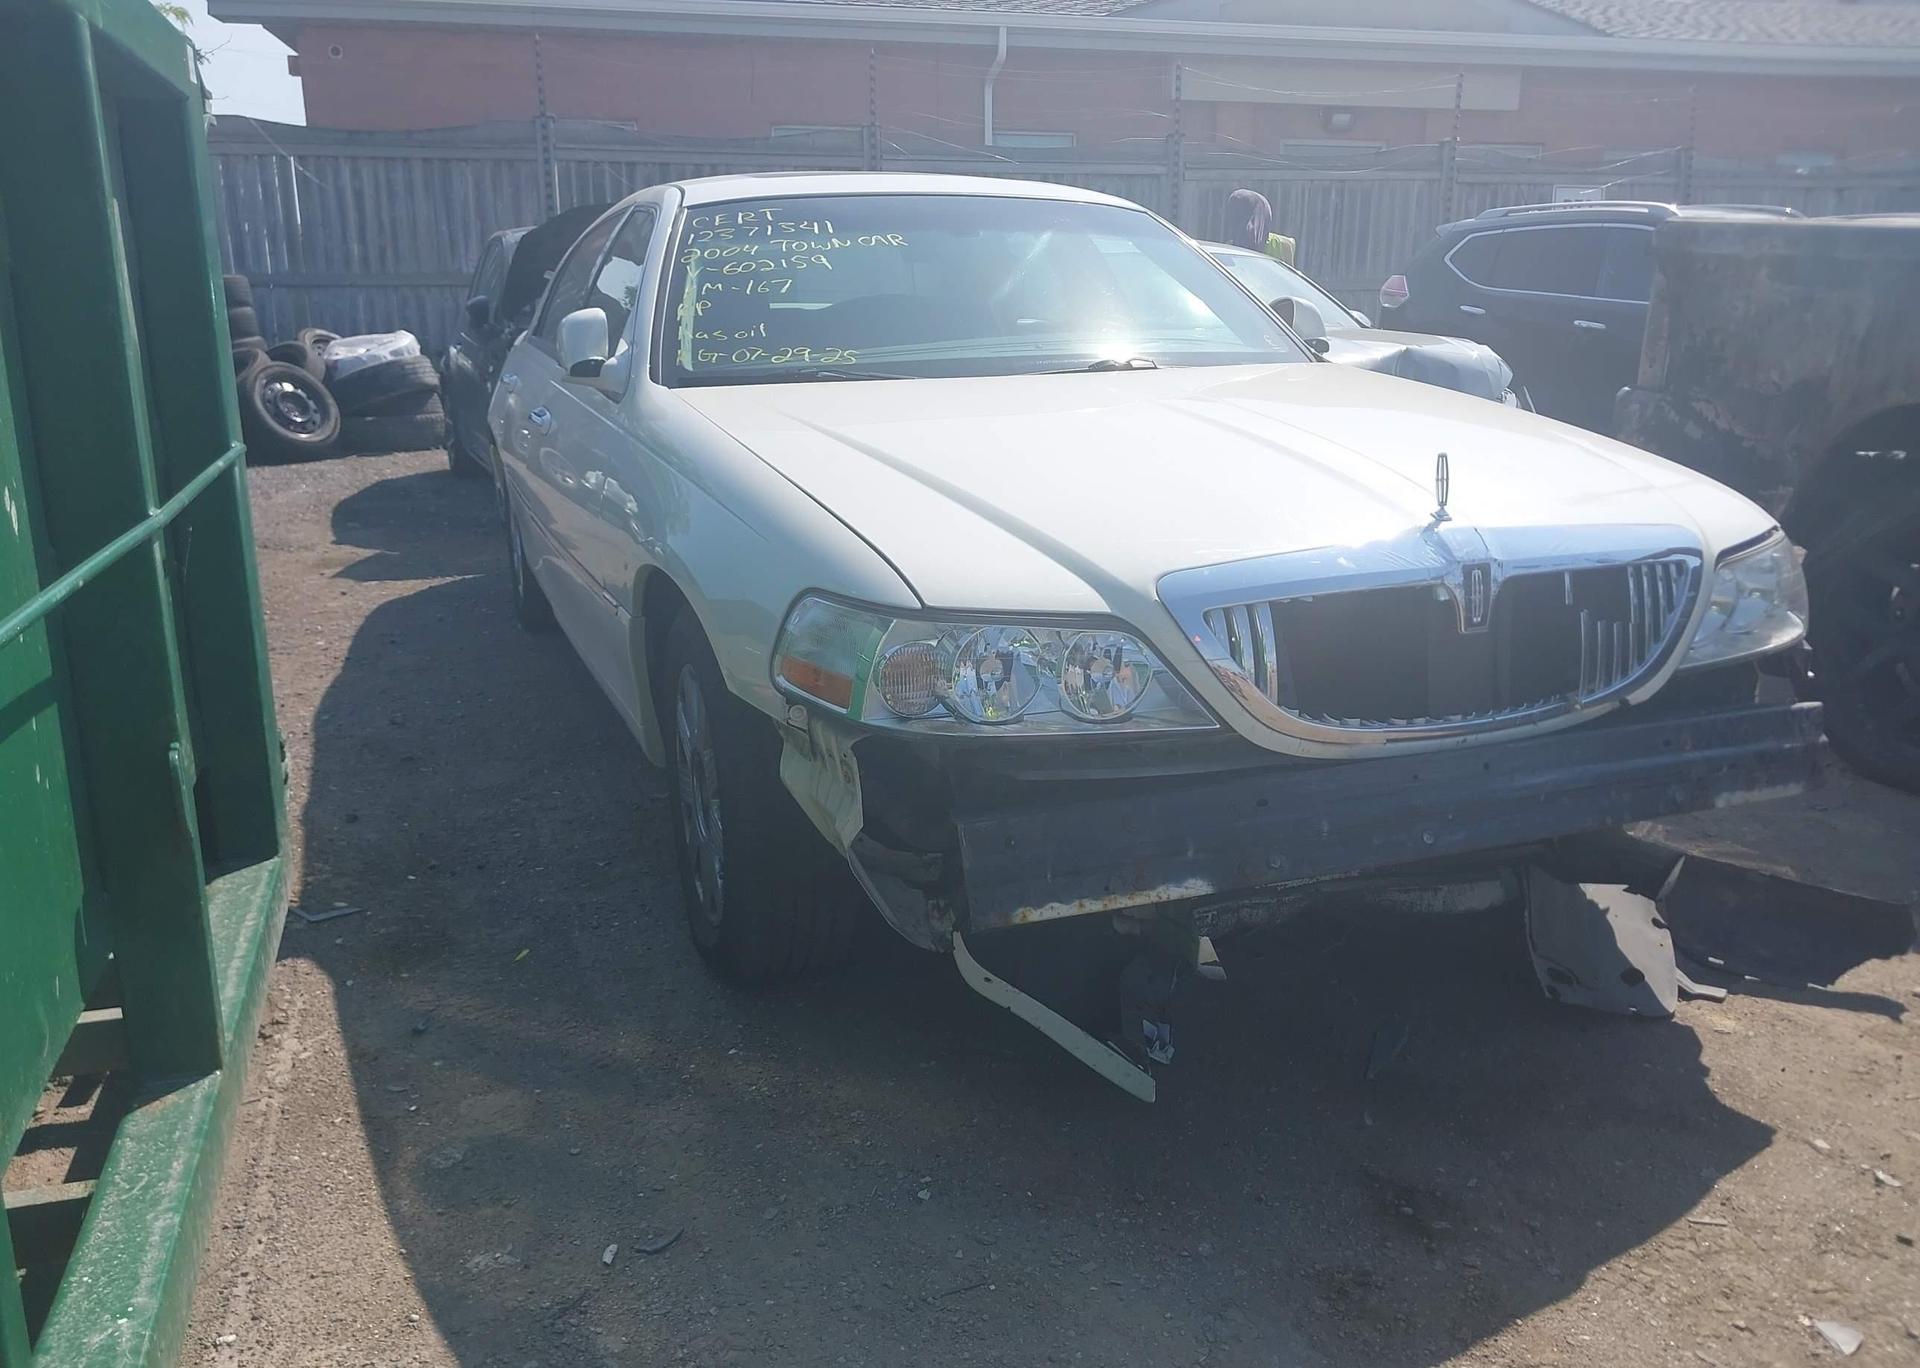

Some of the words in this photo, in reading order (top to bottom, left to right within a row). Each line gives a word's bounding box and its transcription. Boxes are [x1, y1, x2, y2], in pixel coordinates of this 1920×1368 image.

[692, 208, 783, 229] CERT
[687, 220, 835, 245] 12371541
[680, 244, 760, 264] 2004
[769, 238, 851, 253] TOWN
[857, 233, 909, 248] CAR
[734, 322, 768, 339] oil
